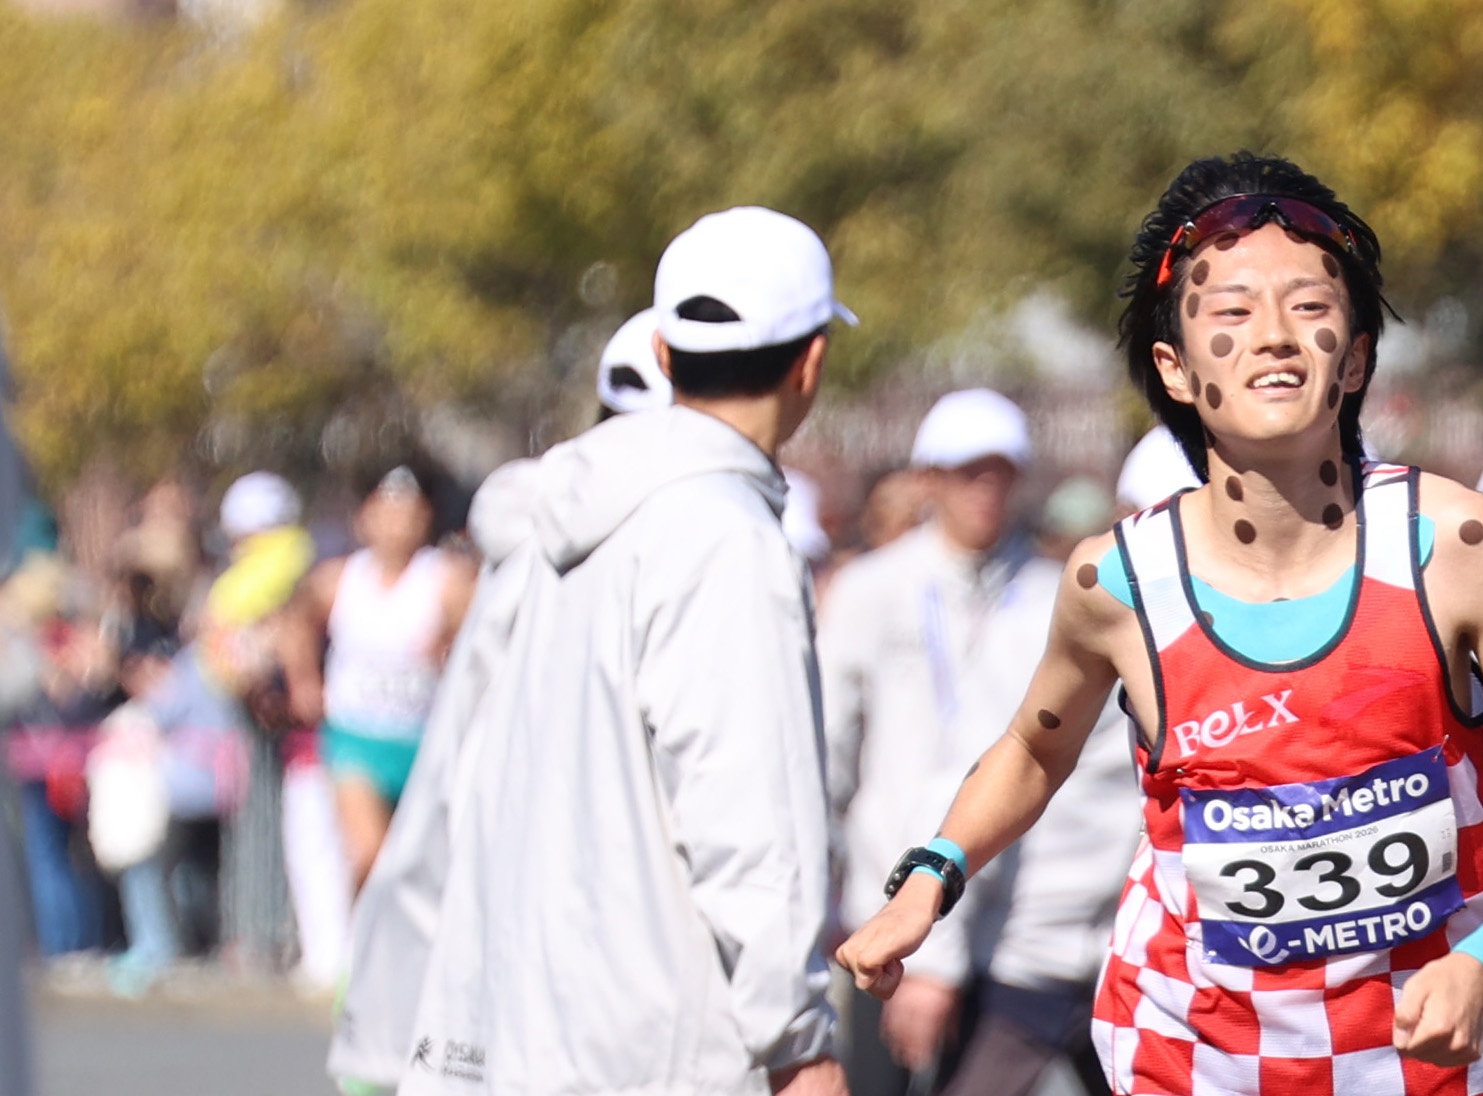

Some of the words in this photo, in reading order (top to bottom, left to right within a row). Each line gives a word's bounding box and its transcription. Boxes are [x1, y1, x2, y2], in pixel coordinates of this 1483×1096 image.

[1202, 799, 1316, 832] Osaka
[1321, 772, 1430, 822] Metro
[1260, 844, 1295, 855] OSAKA
[1297, 832, 1353, 851] MARATHON
[1218, 831, 1430, 919] 339
